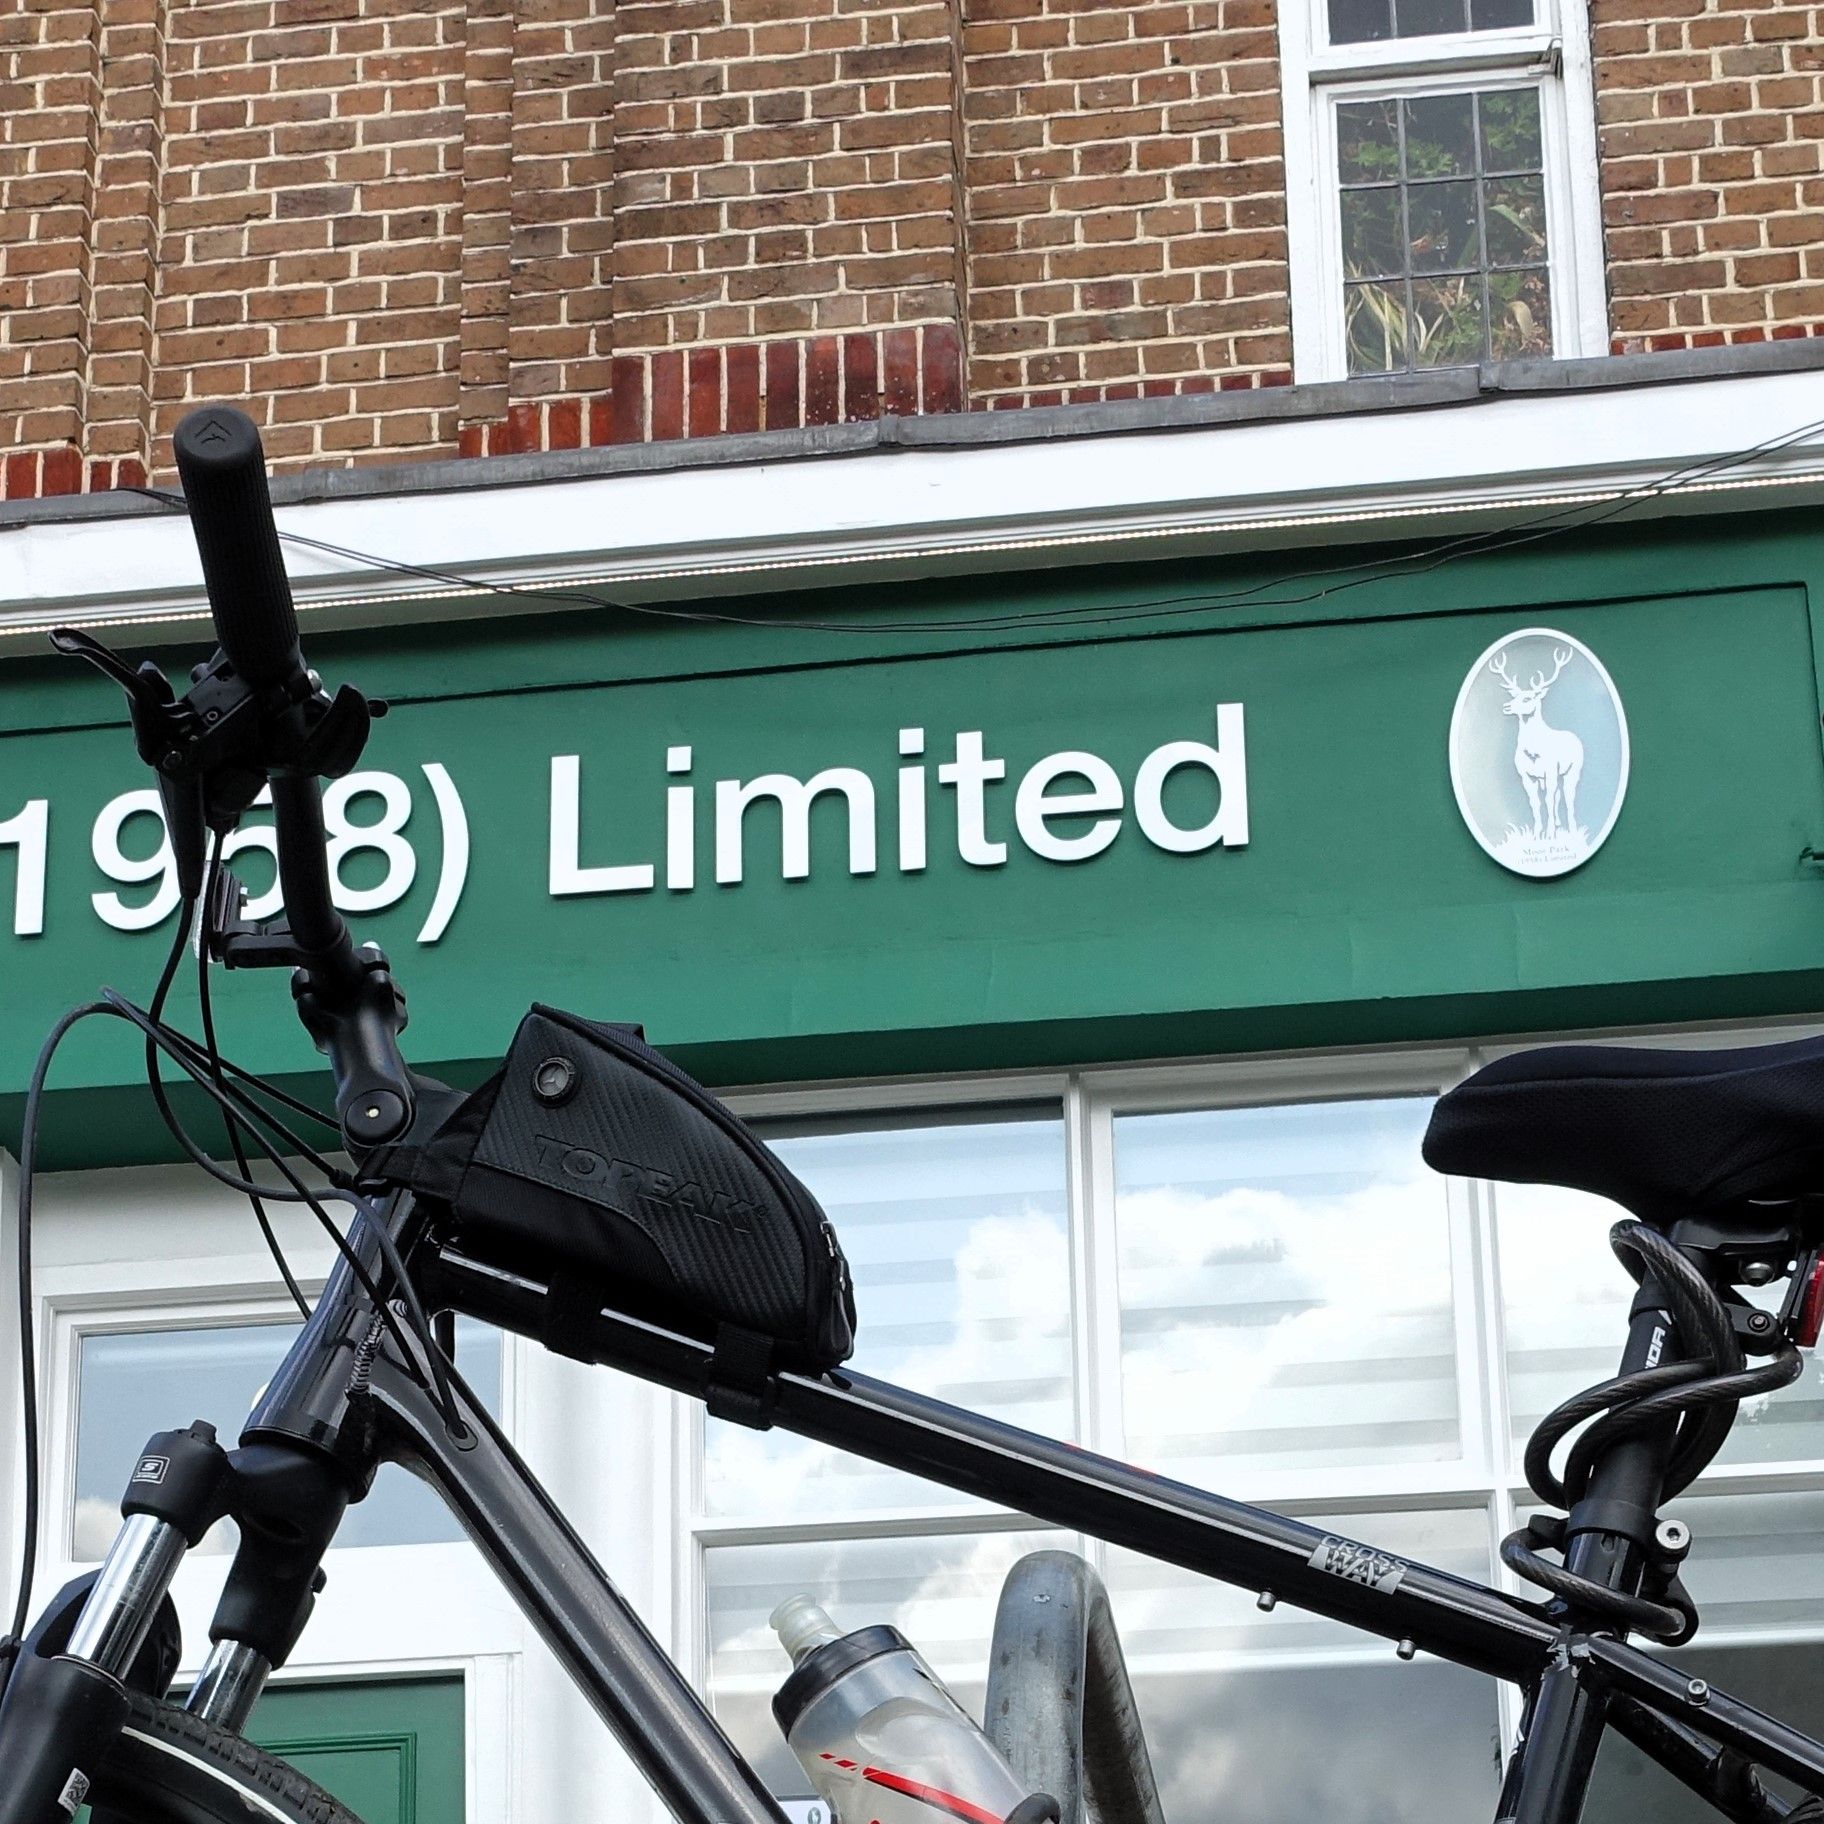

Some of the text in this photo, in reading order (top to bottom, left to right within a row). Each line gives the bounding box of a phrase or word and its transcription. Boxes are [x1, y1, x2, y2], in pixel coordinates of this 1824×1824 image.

[548, 702, 1250, 896] Limited
[1321, 1535, 1408, 1574] CROSS
[1321, 1547, 1396, 1590] WAY
